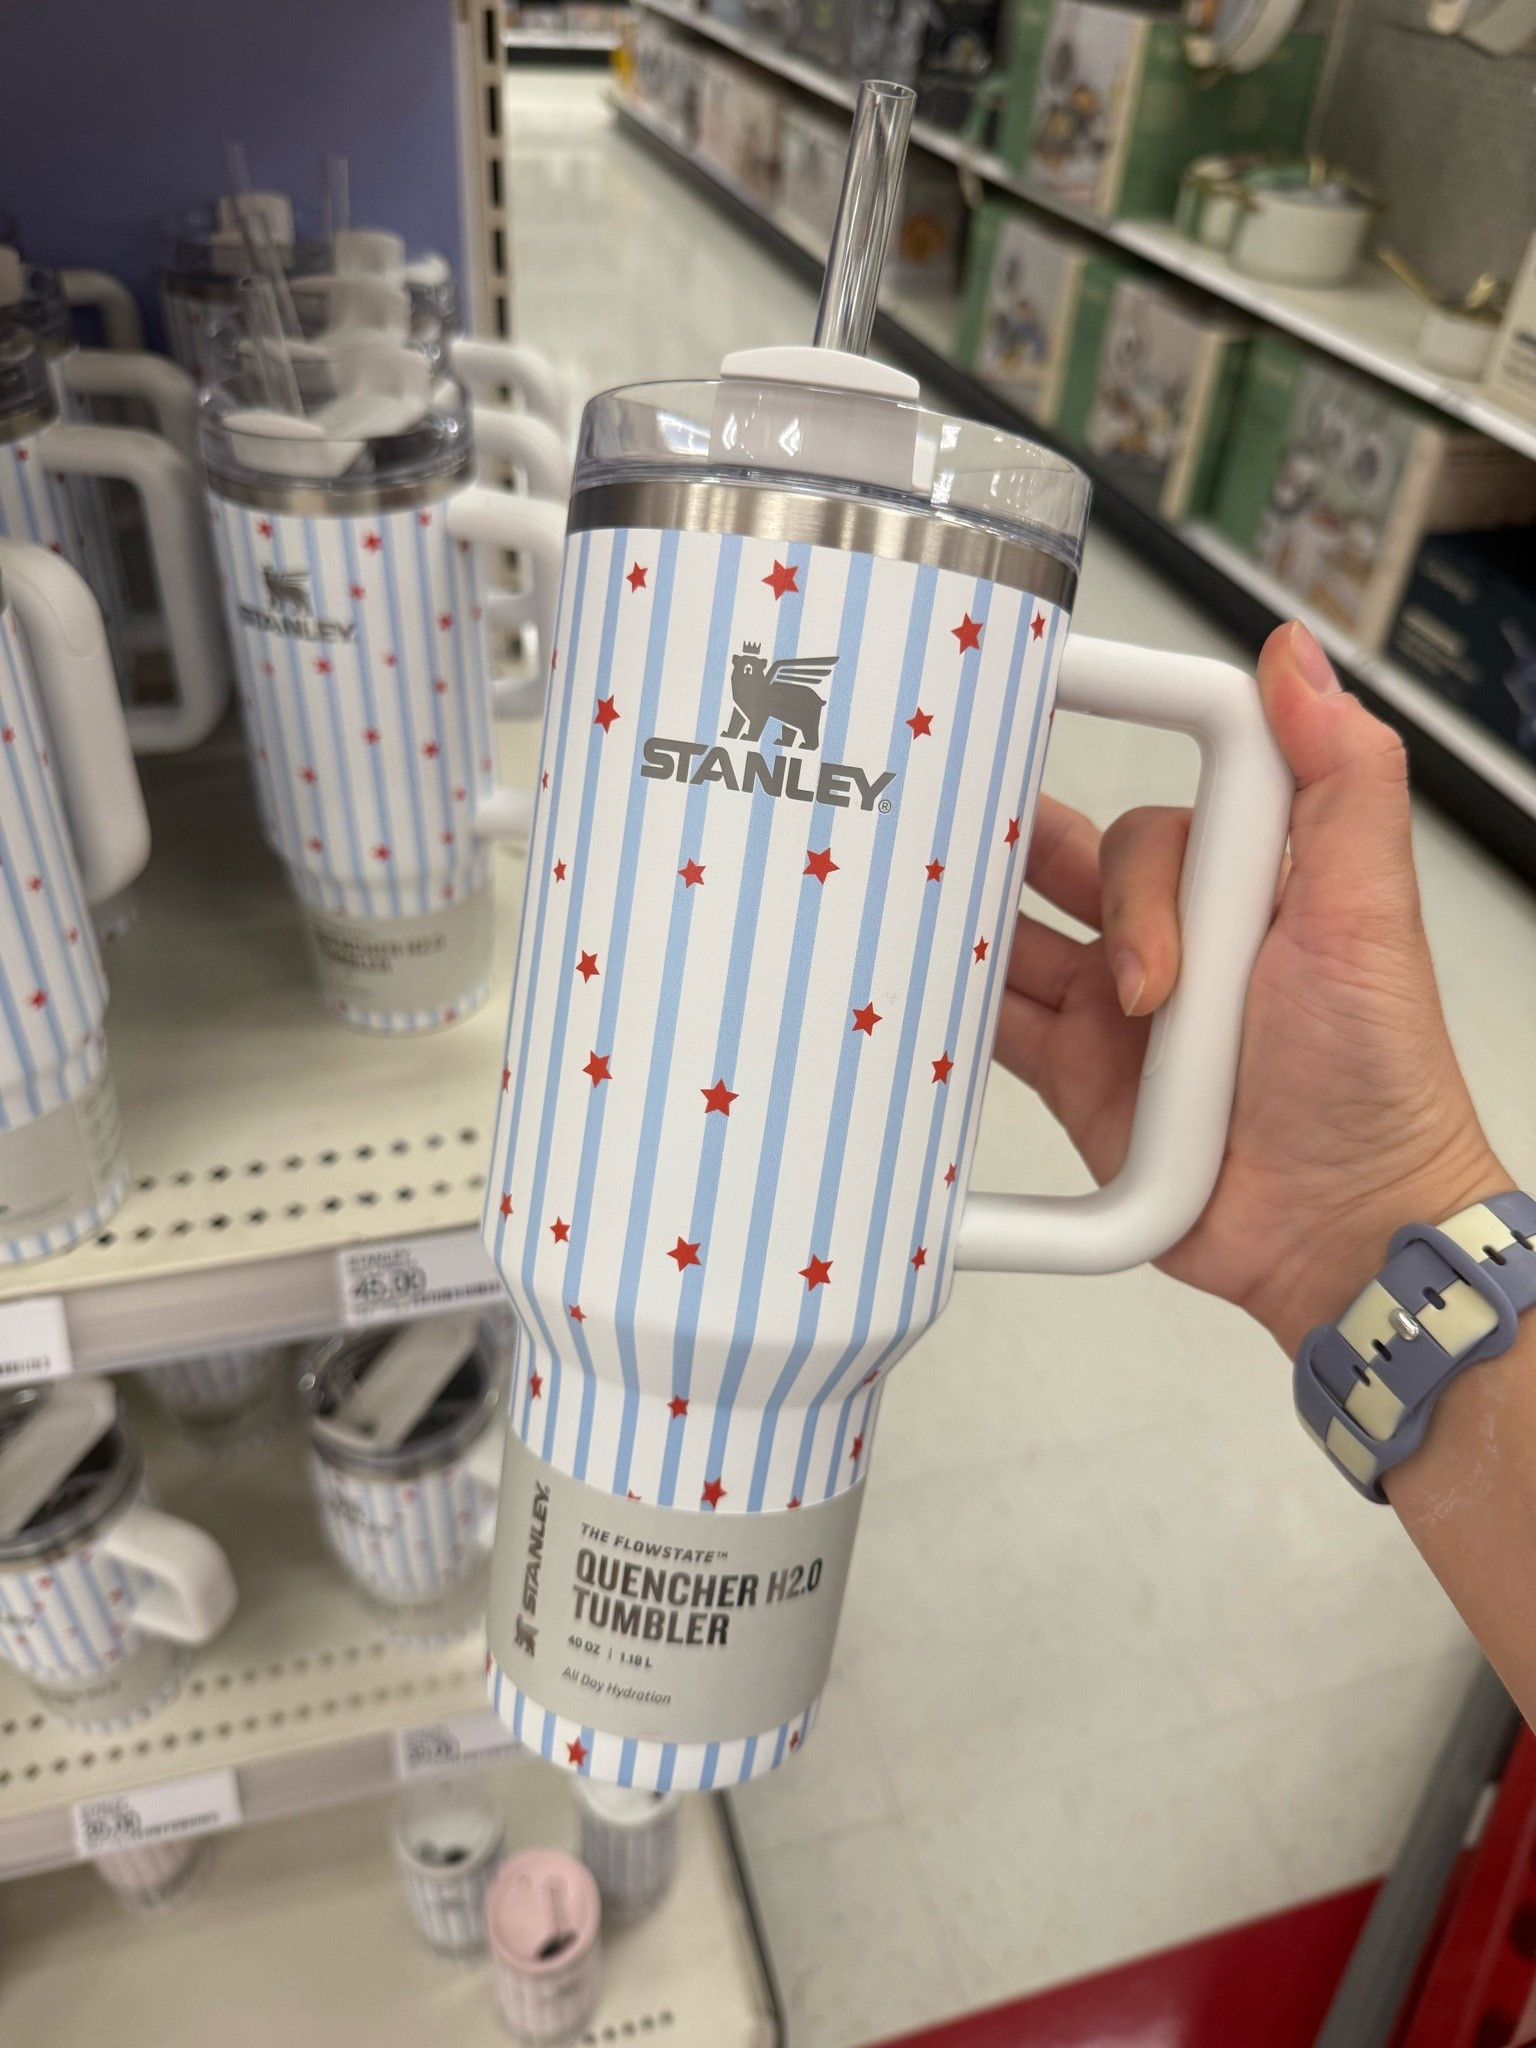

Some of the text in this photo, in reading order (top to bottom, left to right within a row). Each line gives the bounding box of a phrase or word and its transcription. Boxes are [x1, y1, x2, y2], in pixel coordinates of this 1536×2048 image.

[581, 1522, 610, 1543] THE
[575, 1547, 824, 1608] QUENCHER H2.0
[572, 1584, 731, 1646] TUMBLER
[567, 1635, 583, 1649] 40
[584, 1640, 602, 1655] OZ
[562, 1666, 673, 1706] All Day Hydration
